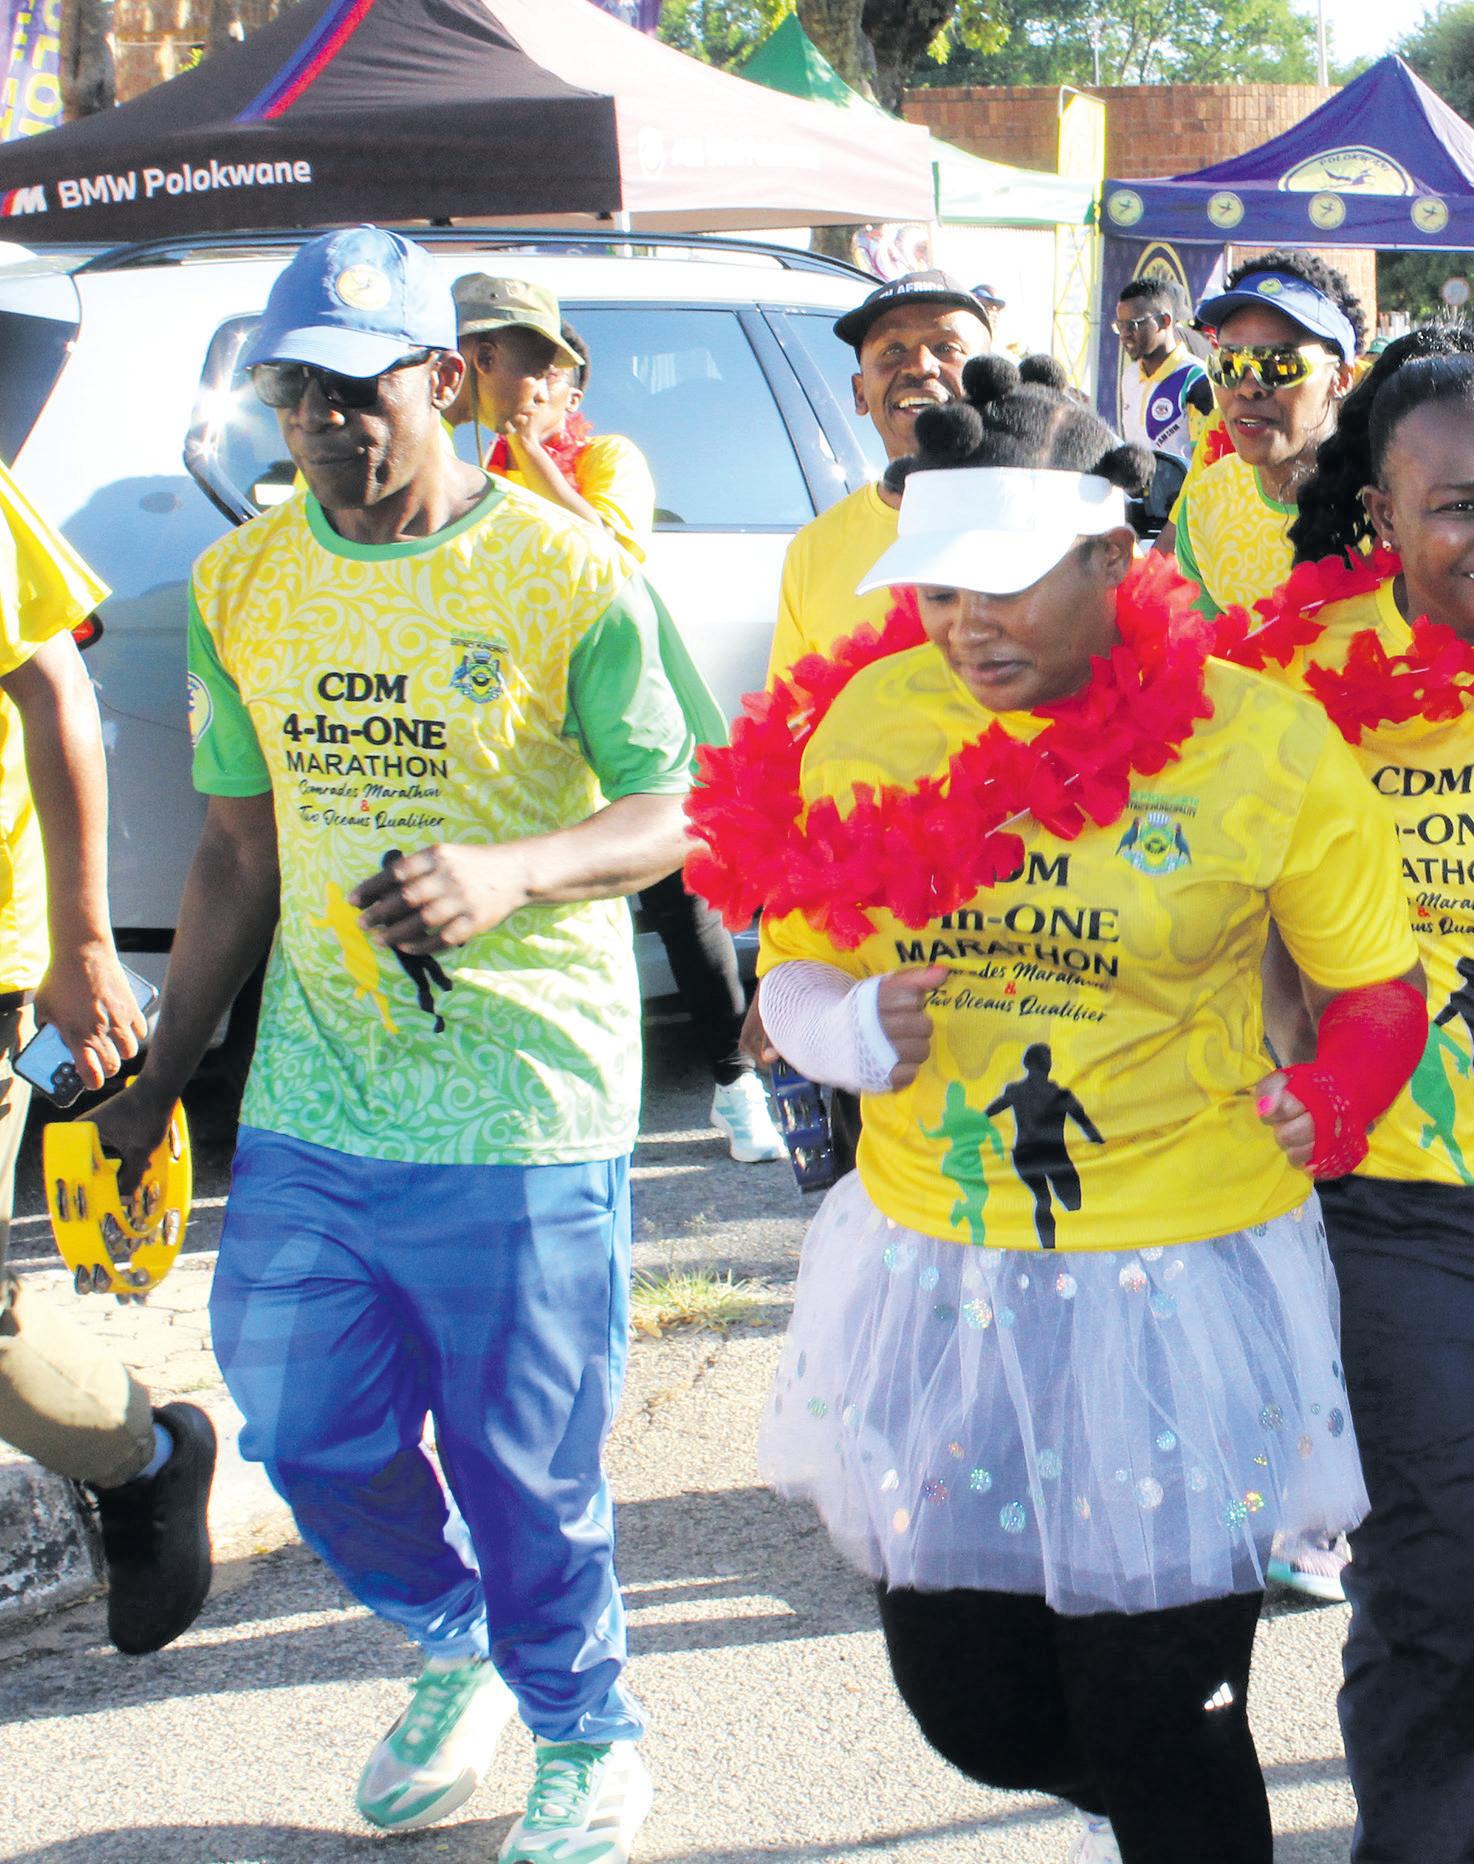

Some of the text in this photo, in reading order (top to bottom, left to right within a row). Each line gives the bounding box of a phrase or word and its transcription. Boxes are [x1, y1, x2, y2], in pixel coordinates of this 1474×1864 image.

[57, 171, 137, 209] BMW
[143, 160, 312, 198] Polokwane
[318, 672, 409, 704] CDM
[283, 712, 448, 750] 4-In-ONE
[286, 751, 448, 779] MARATHON
[299, 778, 359, 799] Comrades
[299, 805, 320, 823] Two
[374, 810, 446, 830] Qualifier
[359, 800, 370, 813] &
[895, 936, 1119, 978] MARATHON
[954, 988, 1015, 1013] Oceans
[1018, 994, 1107, 1023] Qualifier
